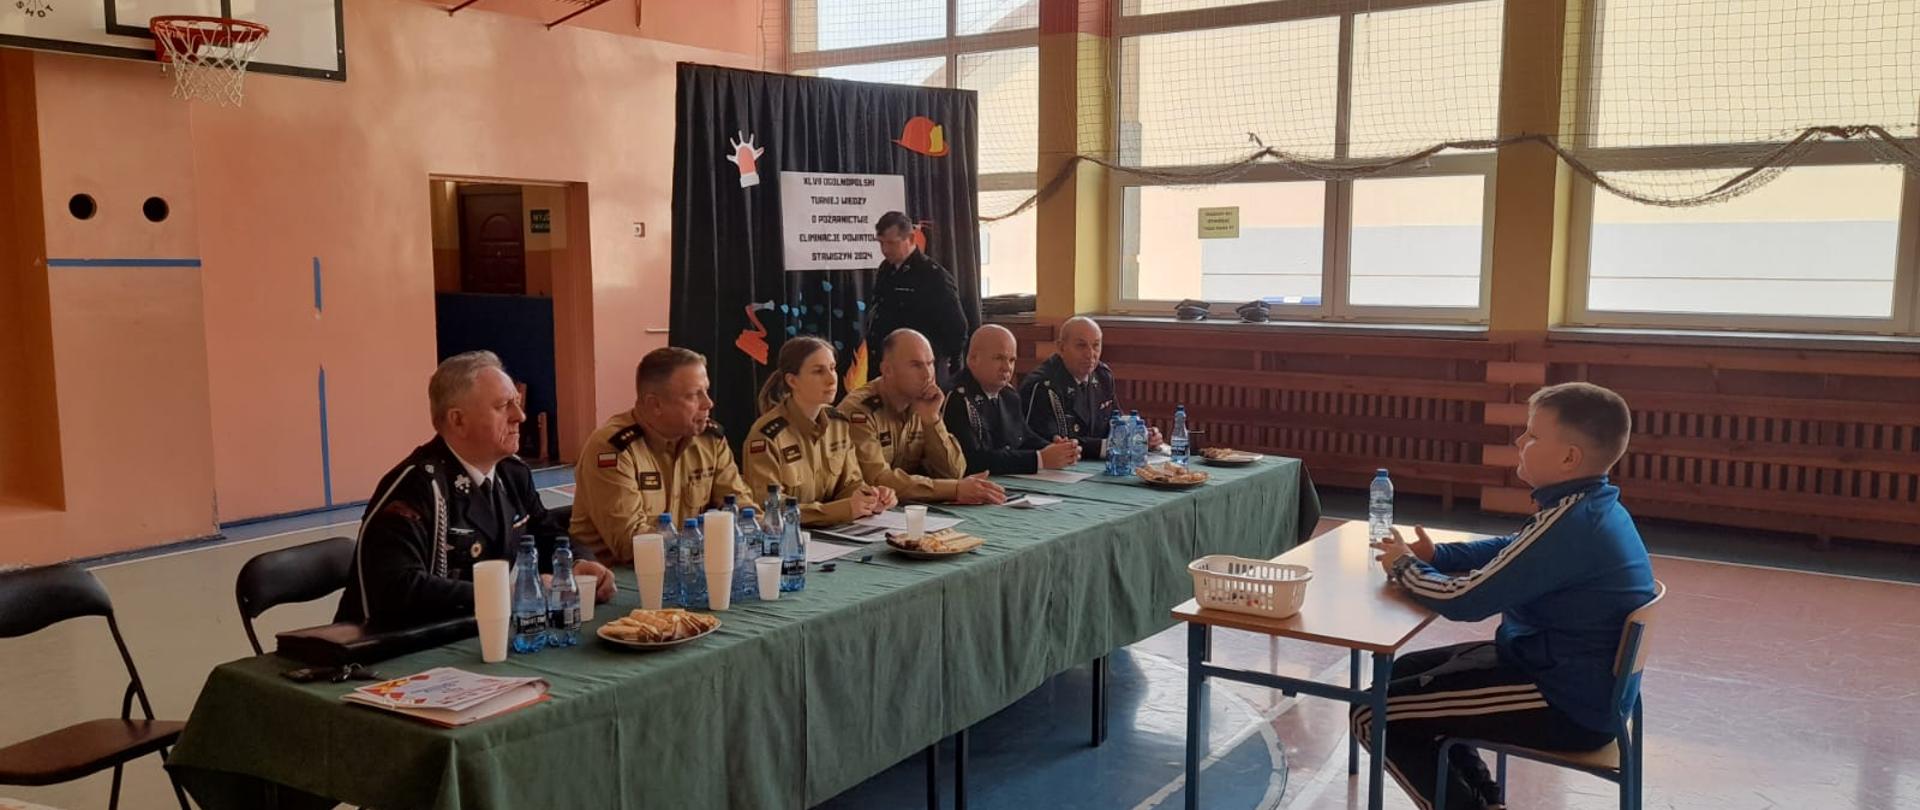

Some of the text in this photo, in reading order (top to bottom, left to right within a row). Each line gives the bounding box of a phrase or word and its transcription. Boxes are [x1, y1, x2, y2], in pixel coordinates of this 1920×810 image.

[811, 196, 867, 205] TURNIEJ WIEDZY
[812, 215, 818, 223] O
[799, 233, 841, 242] ELIMINACJE
[812, 252, 873, 261] STAWISZYN 2024
